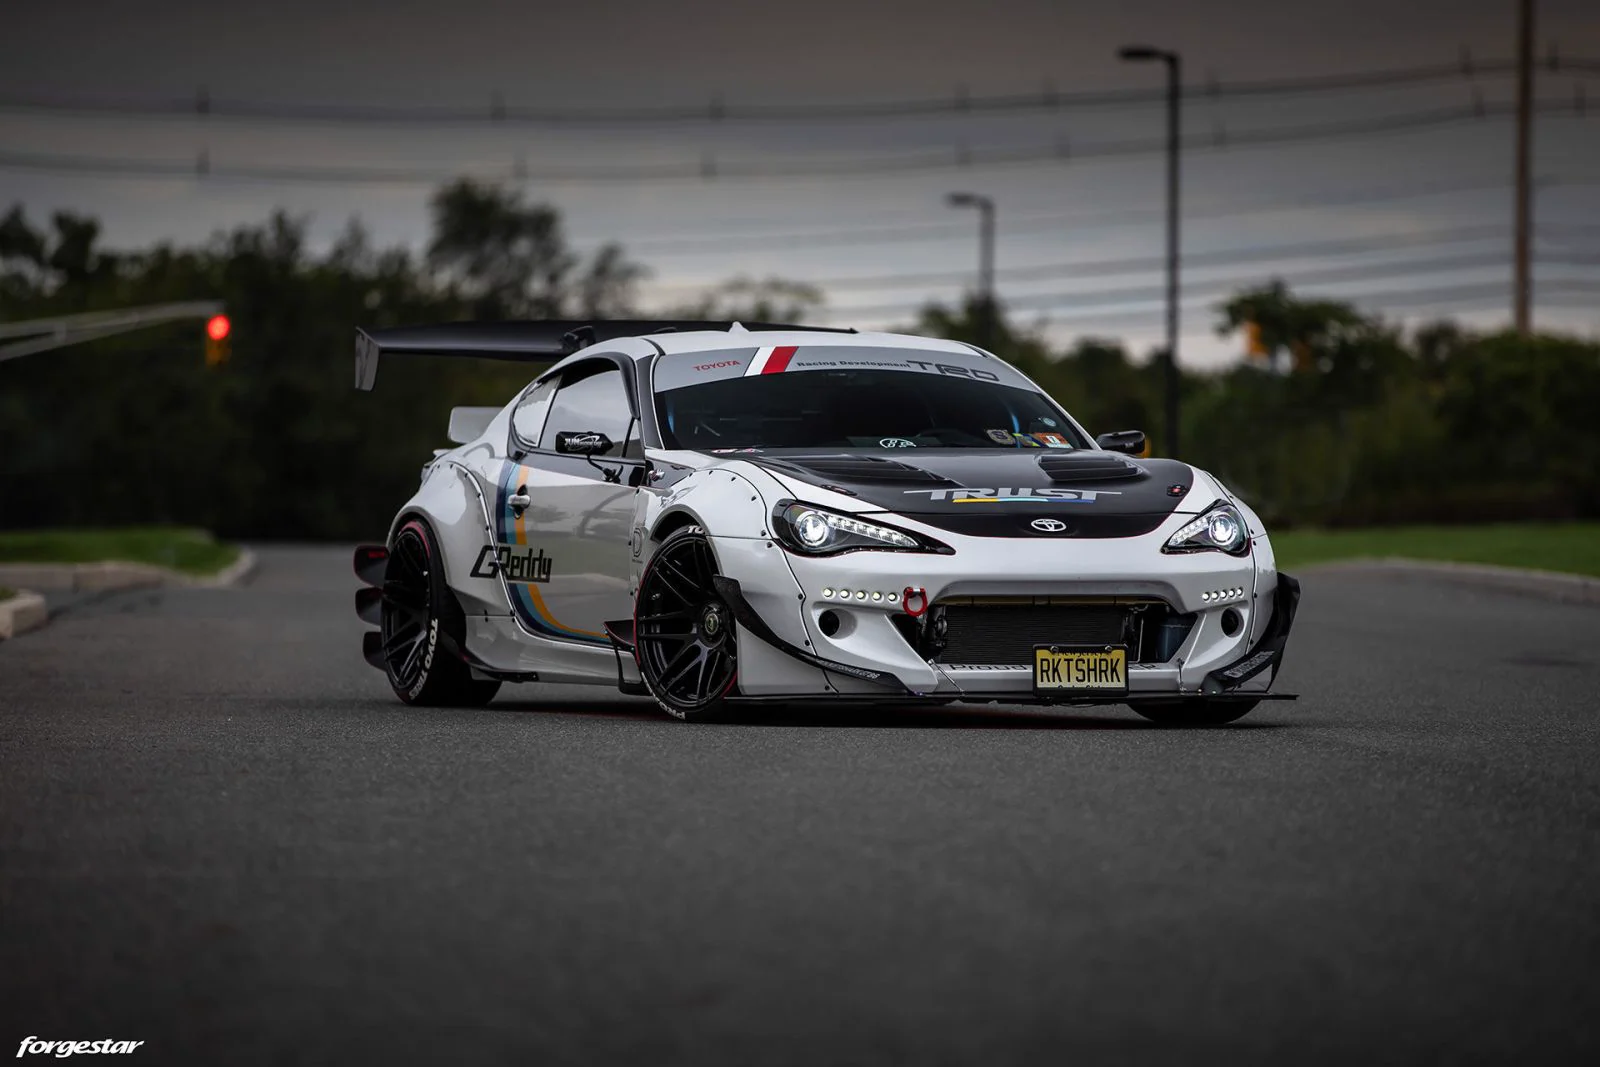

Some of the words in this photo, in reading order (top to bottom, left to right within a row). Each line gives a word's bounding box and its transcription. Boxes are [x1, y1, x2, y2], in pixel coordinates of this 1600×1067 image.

[693, 360, 740, 371] TOYOTA
[797, 360, 836, 368] Racing
[839, 360, 911, 368] Development
[906, 360, 1000, 382] TRD
[904, 488, 1122, 501] TRUST
[470, 545, 552, 583] GReddy
[424, 618, 438, 669] TOYO
[1040, 658, 1121, 683] RKTSHRK
